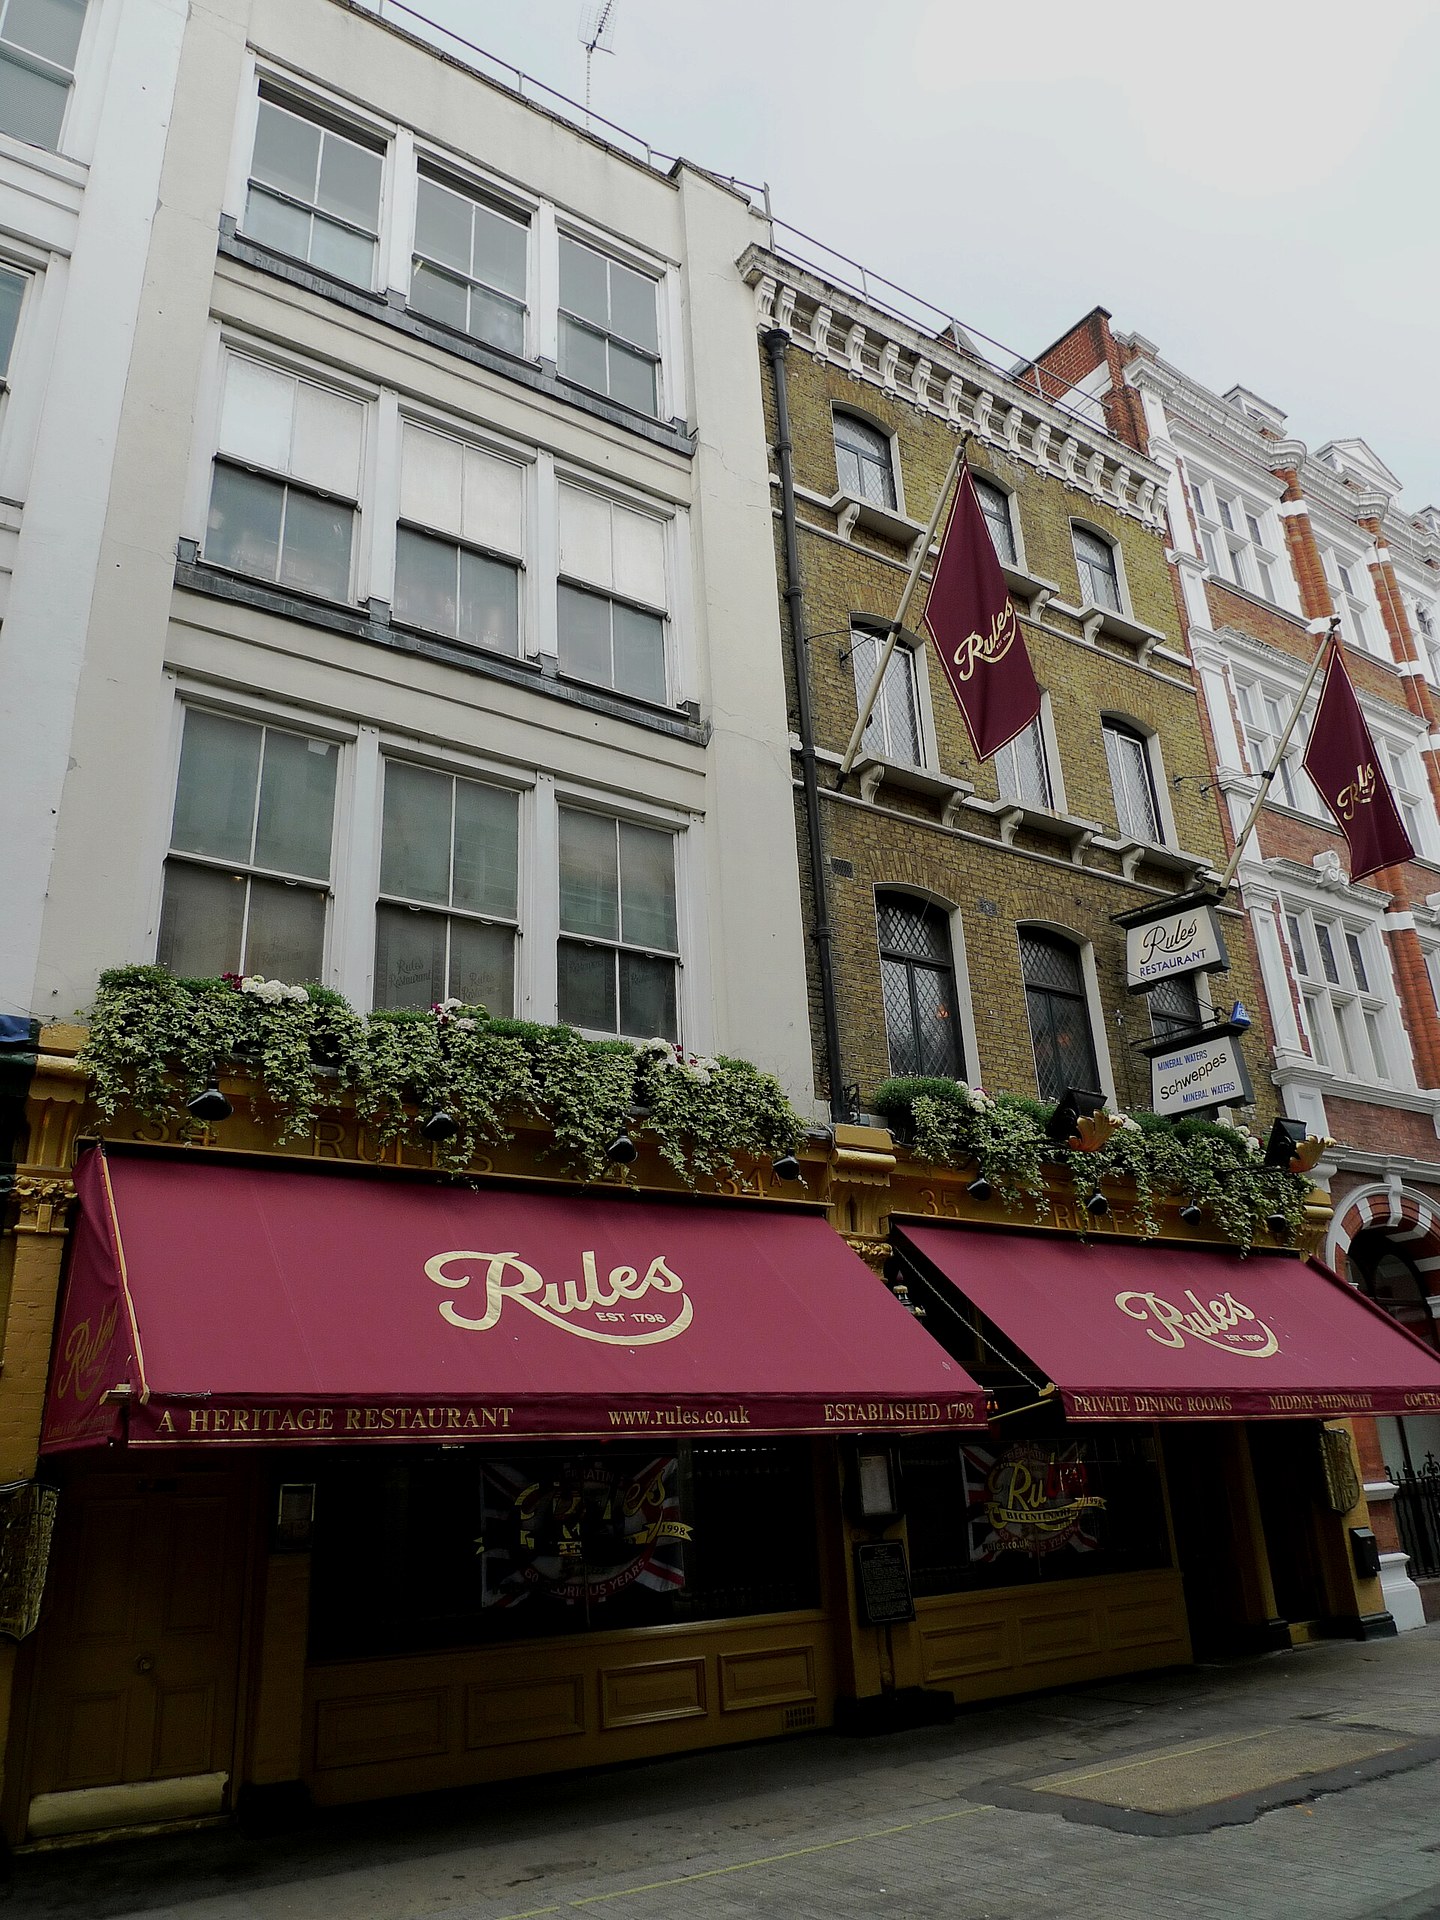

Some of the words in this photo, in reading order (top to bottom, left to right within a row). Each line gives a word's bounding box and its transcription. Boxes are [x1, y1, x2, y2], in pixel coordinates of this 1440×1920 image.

[953, 596, 1017, 681] Rules
[1140, 918, 1197, 965] Rules
[1139, 948, 1207, 977] RESTAURANT
[1157, 1056, 1183, 1072] MINERAL
[1184, 1049, 1208, 1064] WATERS
[1160, 1052, 1227, 1100] Schweppes
[1182, 1088, 1209, 1103] MINERAL
[1210, 1081, 1236, 1096] WATERS
[919, 1188, 961, 1218] 35
[423, 1250, 694, 1346] Rules
[595, 1311, 626, 1323] EST
[630, 1312, 667, 1324] 1798
[1114, 1289, 1279, 1358] Rules
[1224, 1334, 1243, 1343] EST
[823, 1403, 941, 1422] ESTABLISHED
[946, 1402, 975, 1420] 1798
[1073, 1395, 1132, 1413] PRIVATE
[1134, 1395, 1183, 1413] DINING
[1186, 1395, 1233, 1412] ROOMS
[1268, 1393, 1375, 1411] MIDDAY-MIDNIGHT
[155, 1410, 177, 1433] A
[188, 1408, 334, 1432] HERITAGE
[344, 1407, 514, 1431] RESTAURANT
[608, 1405, 751, 1426] www.rules.co.uk
[661, 1523, 687, 1536] 1998
[524, 1567, 539, 1583] 60
[608, 1558, 646, 1591] YEARS
